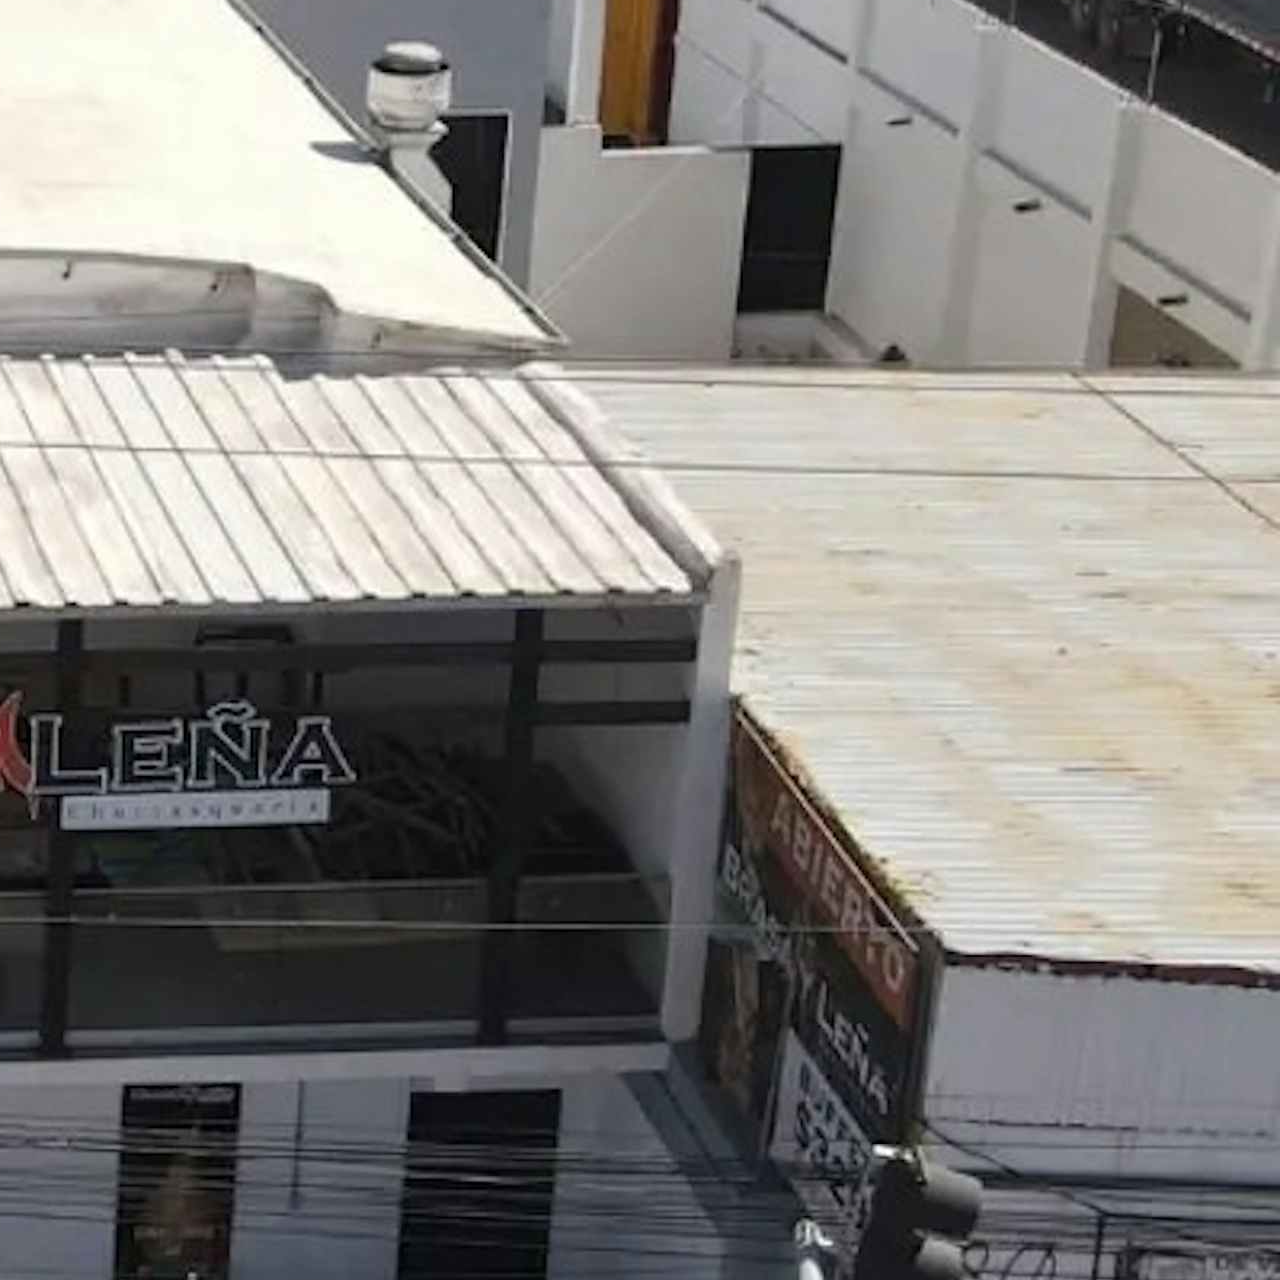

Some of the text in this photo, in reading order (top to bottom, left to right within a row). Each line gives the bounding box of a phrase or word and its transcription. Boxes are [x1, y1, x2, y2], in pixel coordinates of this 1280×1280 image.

[30, 701, 358, 794] LEÑA
[770, 790, 905, 992] ABIERTO
[816, 978, 889, 1117] LEÑA
